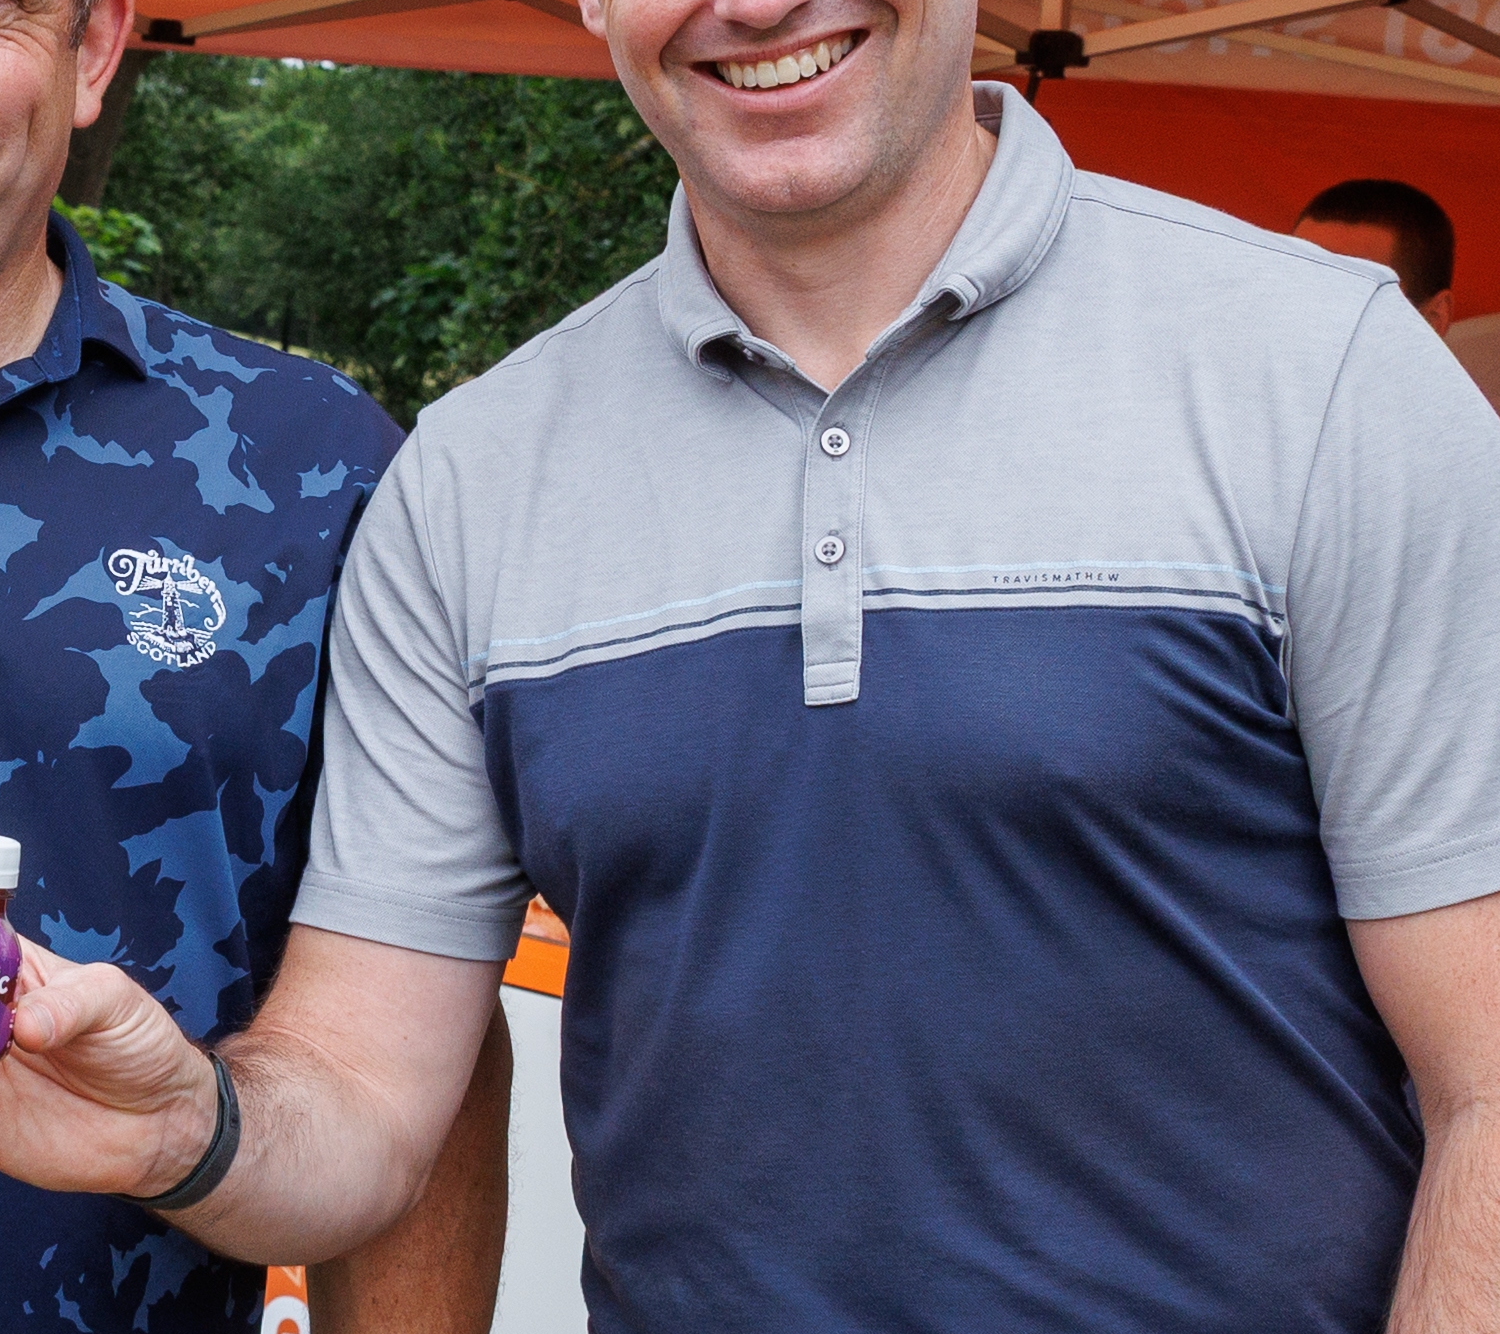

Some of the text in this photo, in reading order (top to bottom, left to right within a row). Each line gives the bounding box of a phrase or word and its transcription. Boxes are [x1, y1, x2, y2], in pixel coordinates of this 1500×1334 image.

[108, 548, 227, 631] Turnberry
[992, 571, 1120, 584] TRAVISMATHEW
[126, 631, 217, 668] SCOTLAND
